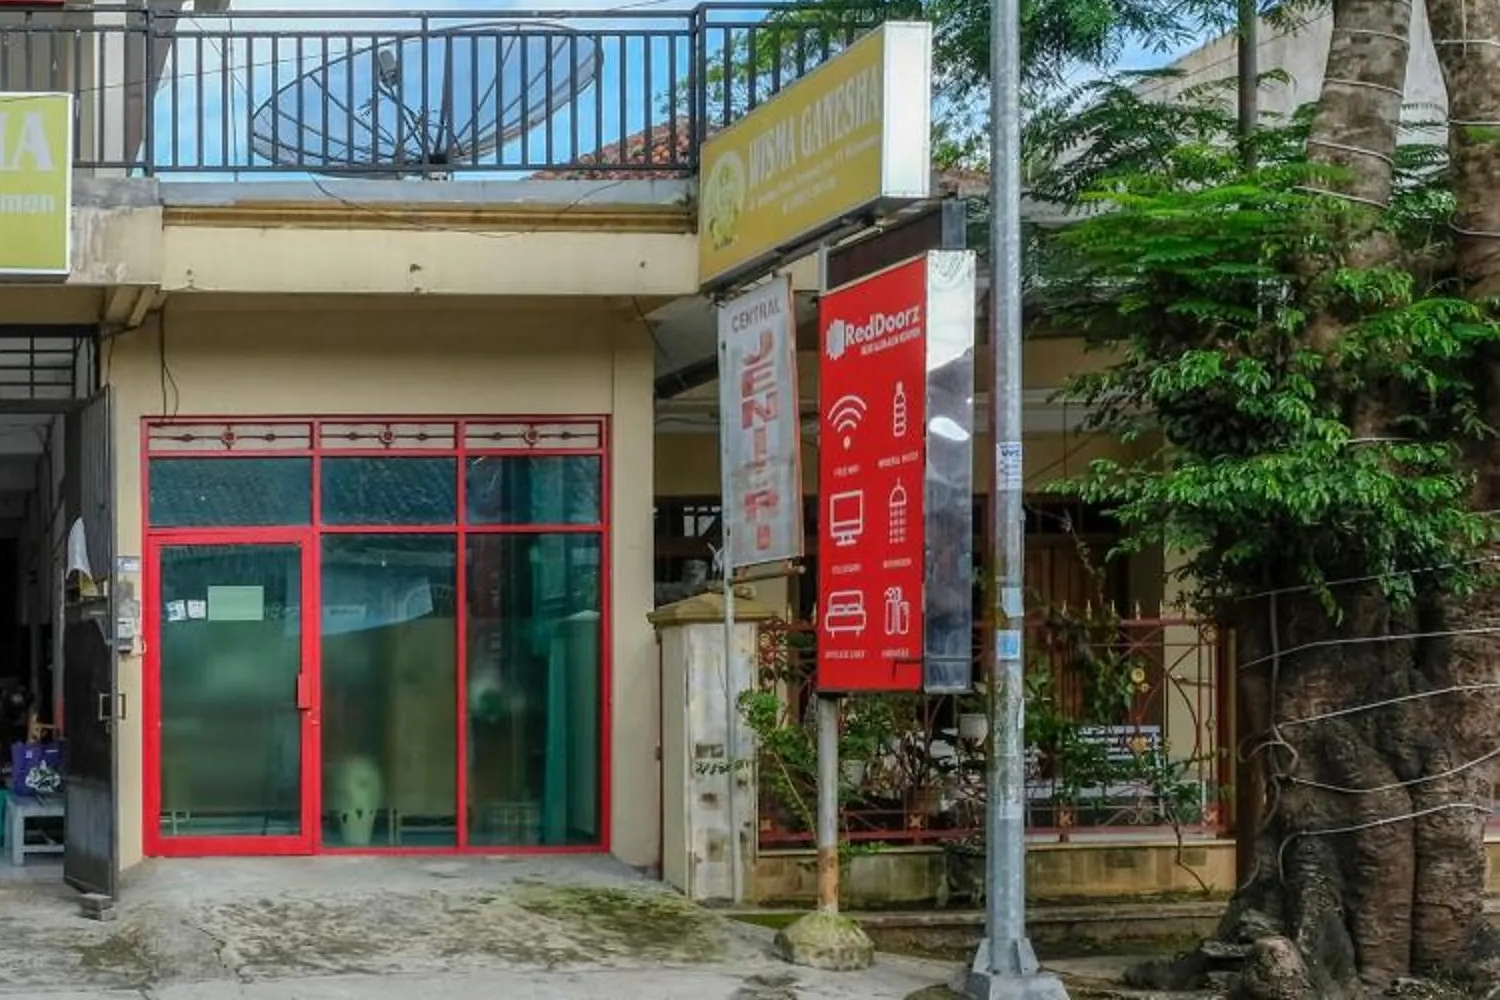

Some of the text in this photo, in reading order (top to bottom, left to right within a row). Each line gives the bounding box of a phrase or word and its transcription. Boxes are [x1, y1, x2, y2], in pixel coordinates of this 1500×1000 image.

[749, 114, 797, 188] WISMA
[801, 63, 880, 162] GANESHA
[731, 296, 781, 333] CENTRAL
[845, 305, 920, 347] RedDoorz
